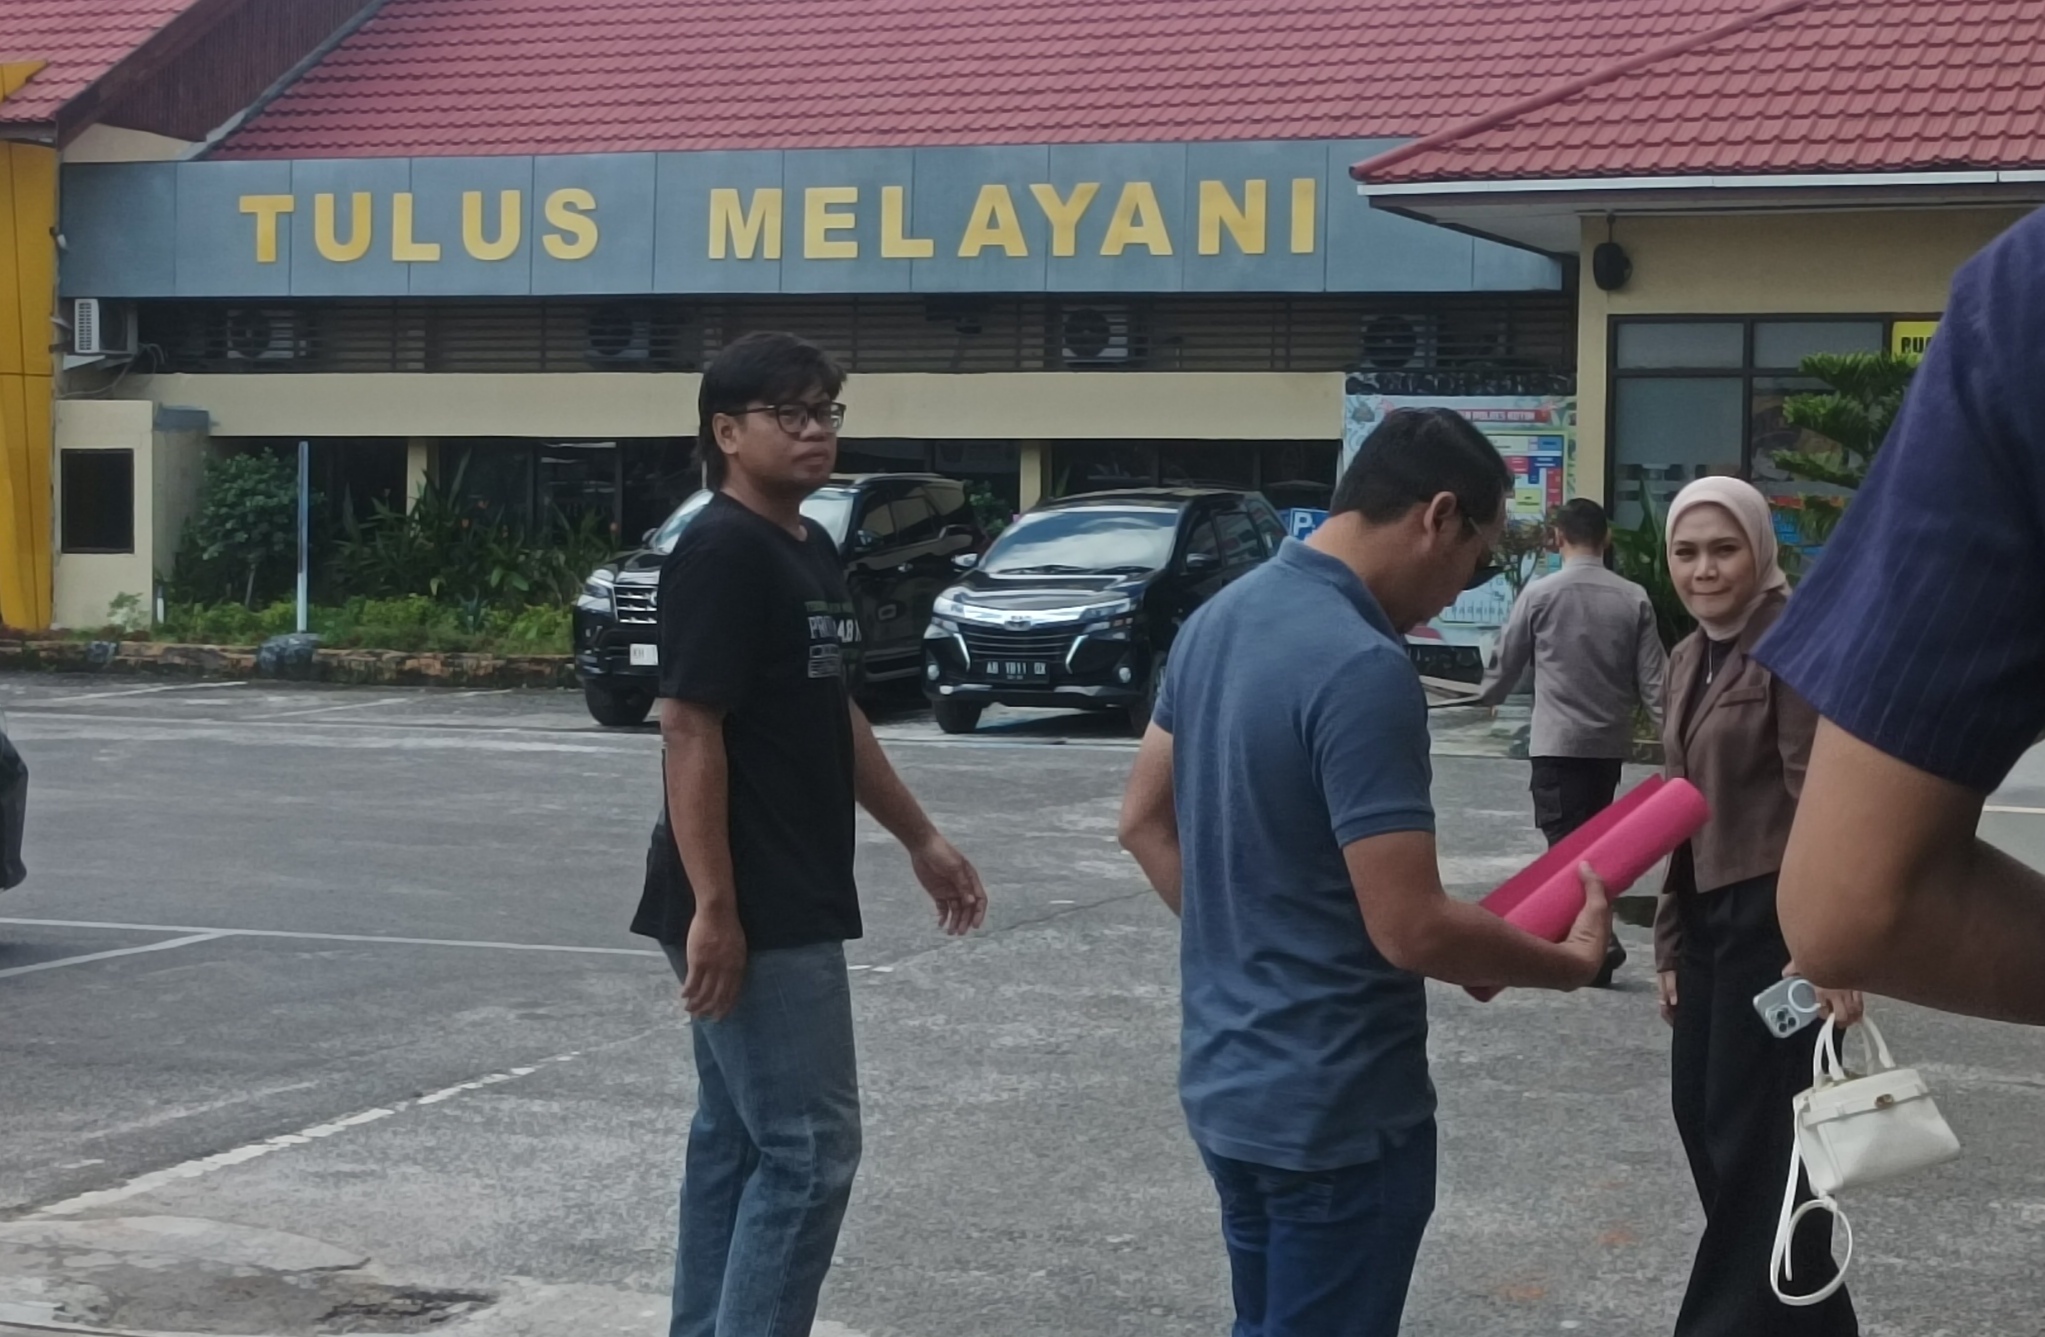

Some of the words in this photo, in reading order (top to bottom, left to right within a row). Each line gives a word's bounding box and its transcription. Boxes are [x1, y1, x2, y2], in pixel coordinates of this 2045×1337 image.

[240, 189, 598, 263] TULUS
[709, 178, 1317, 259] MELAYANI
[1293, 511, 1313, 537] P
